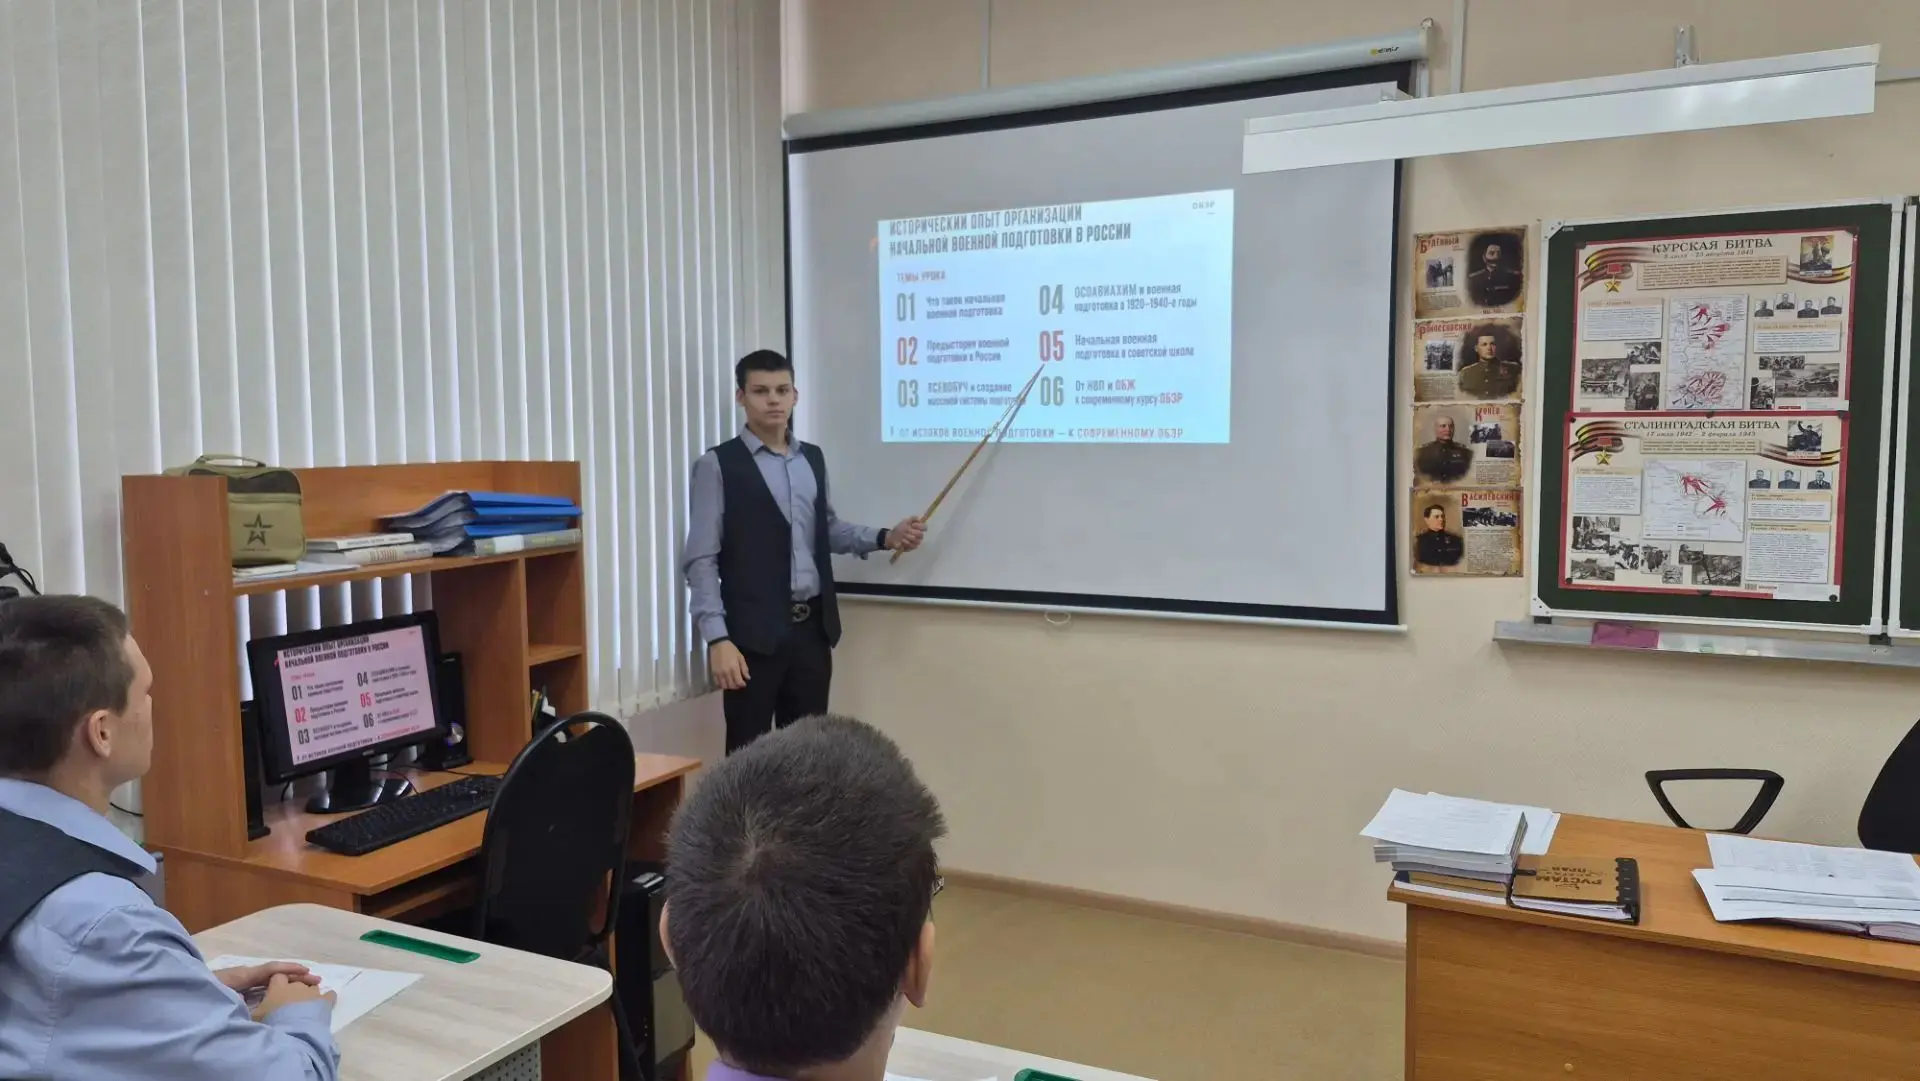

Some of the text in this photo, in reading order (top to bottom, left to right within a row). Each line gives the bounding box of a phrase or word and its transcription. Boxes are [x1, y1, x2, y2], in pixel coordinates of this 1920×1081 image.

[971, 212, 1000, 230] ОПЫТ
[1004, 205, 1082, 227] ОРГАНИЗАЦИИ
[890, 223, 1131, 258] НАЧАЛЬНОЙ ВОЕННОЙ ПОДГОТОВКИ В РОССИИ
[1652, 238, 1773, 253] КУРСКАЯ БИТВА
[897, 270, 945, 283] ТЕМЫ УРОКА
[1074, 284, 1181, 298] ОСОАВИАХИМ и военная
[897, 292, 915, 322] 01
[1039, 284, 1064, 315] 04
[1074, 301, 1118, 313] подготовка
[1179, 298, 1197, 309] годы
[1039, 330, 1064, 362] 05
[1075, 334, 1157, 346] Начальная военная
[897, 336, 918, 366] 02
[975, 351, 1001, 361] России
[1075, 350, 1120, 360] подготовка
[1128, 347, 1167, 358] советской
[1169, 347, 1194, 357] школе
[898, 379, 919, 407] 03
[977, 383, 1012, 394] создание
[1040, 376, 1064, 407] 06
[1075, 379, 1136, 392] От НВП и ОБЖ
[1081, 395, 1134, 406] современному
[1136, 395, 1158, 407] курсу
[1160, 392, 1183, 404] ОБЗР
[1068, 428, 1074, 437] К
[1078, 427, 1155, 438] СОВРЕМЕННОМУ
[1624, 420, 1780, 430] СТАЛИНГРАДСКАЯ БИТВА
[357, 671, 368, 687] 04
[292, 685, 302, 701] 01
[360, 692, 371, 708] 05
[295, 706, 306, 723] 02
[363, 713, 374, 728] 06
[298, 728, 310, 744] 03
